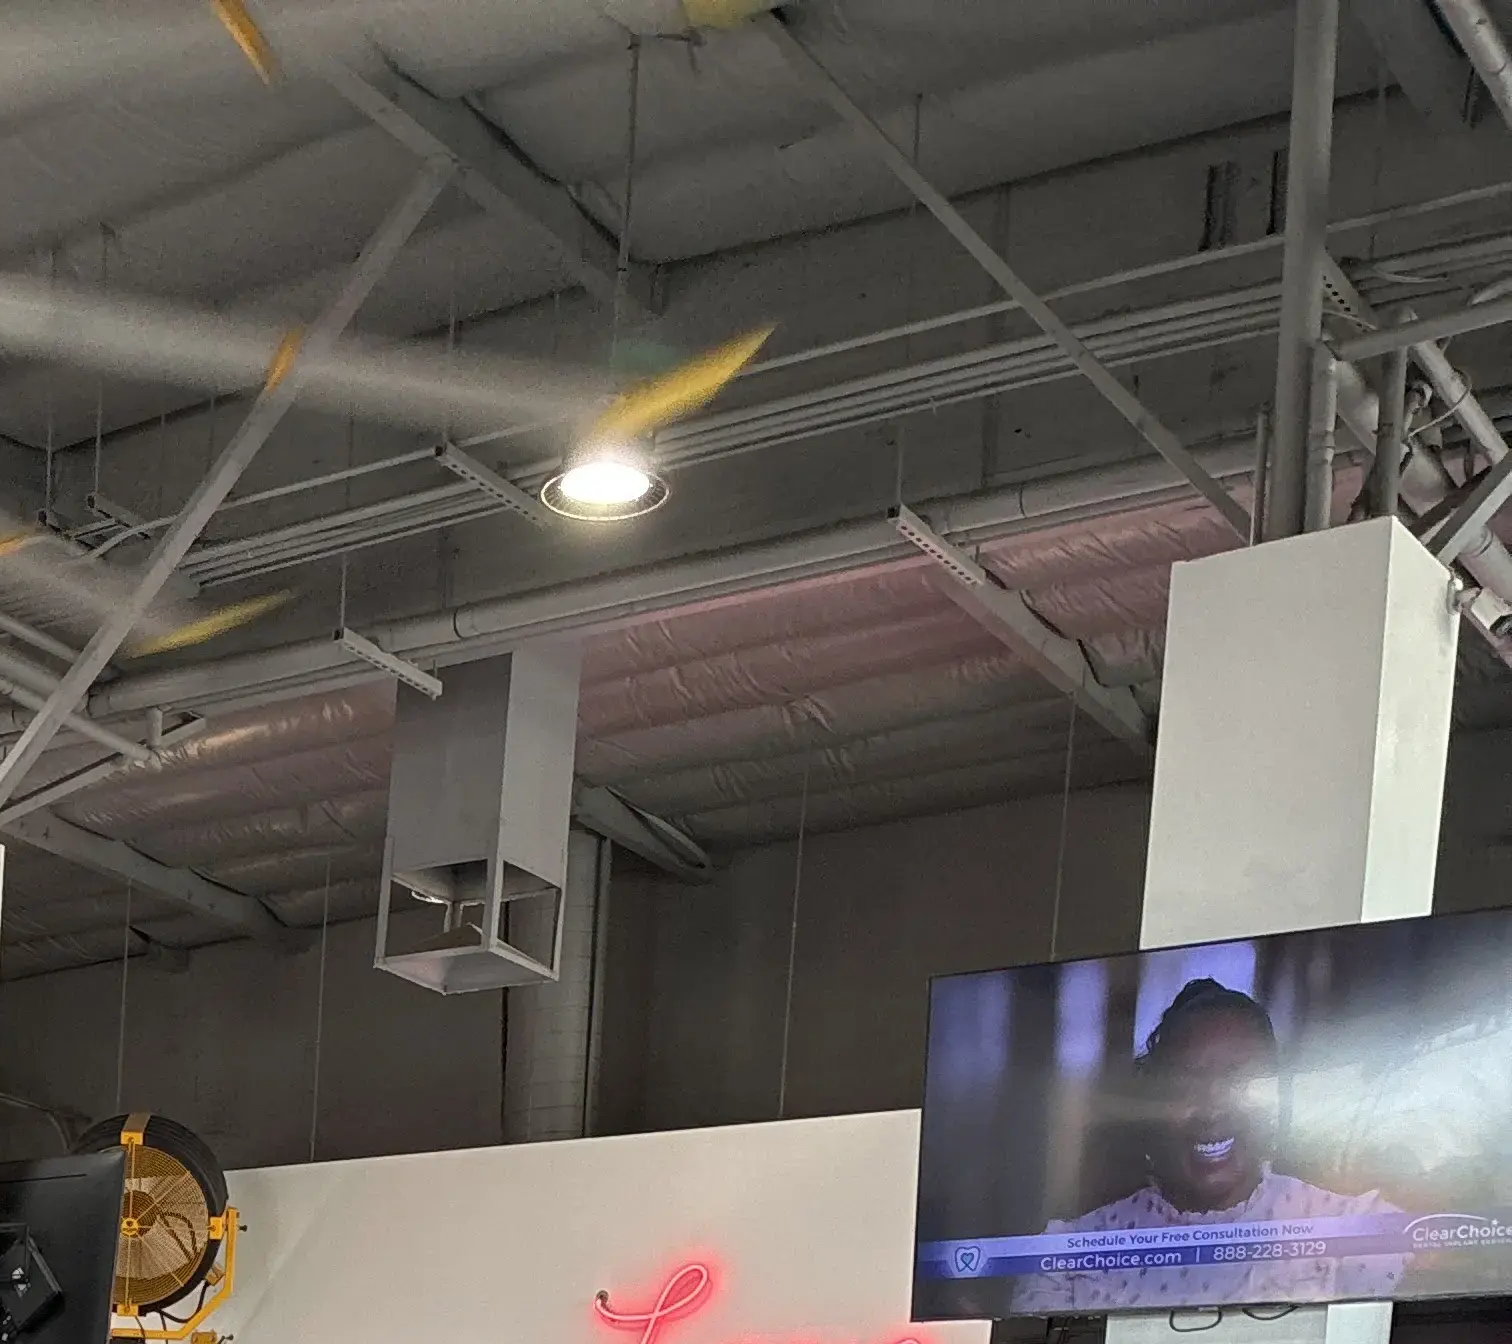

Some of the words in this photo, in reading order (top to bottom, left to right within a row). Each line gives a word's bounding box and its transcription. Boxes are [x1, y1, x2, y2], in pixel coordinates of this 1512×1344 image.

[1067, 1235, 1126, 1248] Schedule
[1129, 1233, 1158, 1245] Your
[1162, 1231, 1189, 1243] Free
[1192, 1226, 1279, 1242] Consultation
[1282, 1224, 1314, 1236] Now
[1412, 1220, 1512, 1242] ClearChoice
[1040, 1251, 1181, 1271] ClearChoice.com
[1214, 1241, 1326, 1261] 888-228-3129
